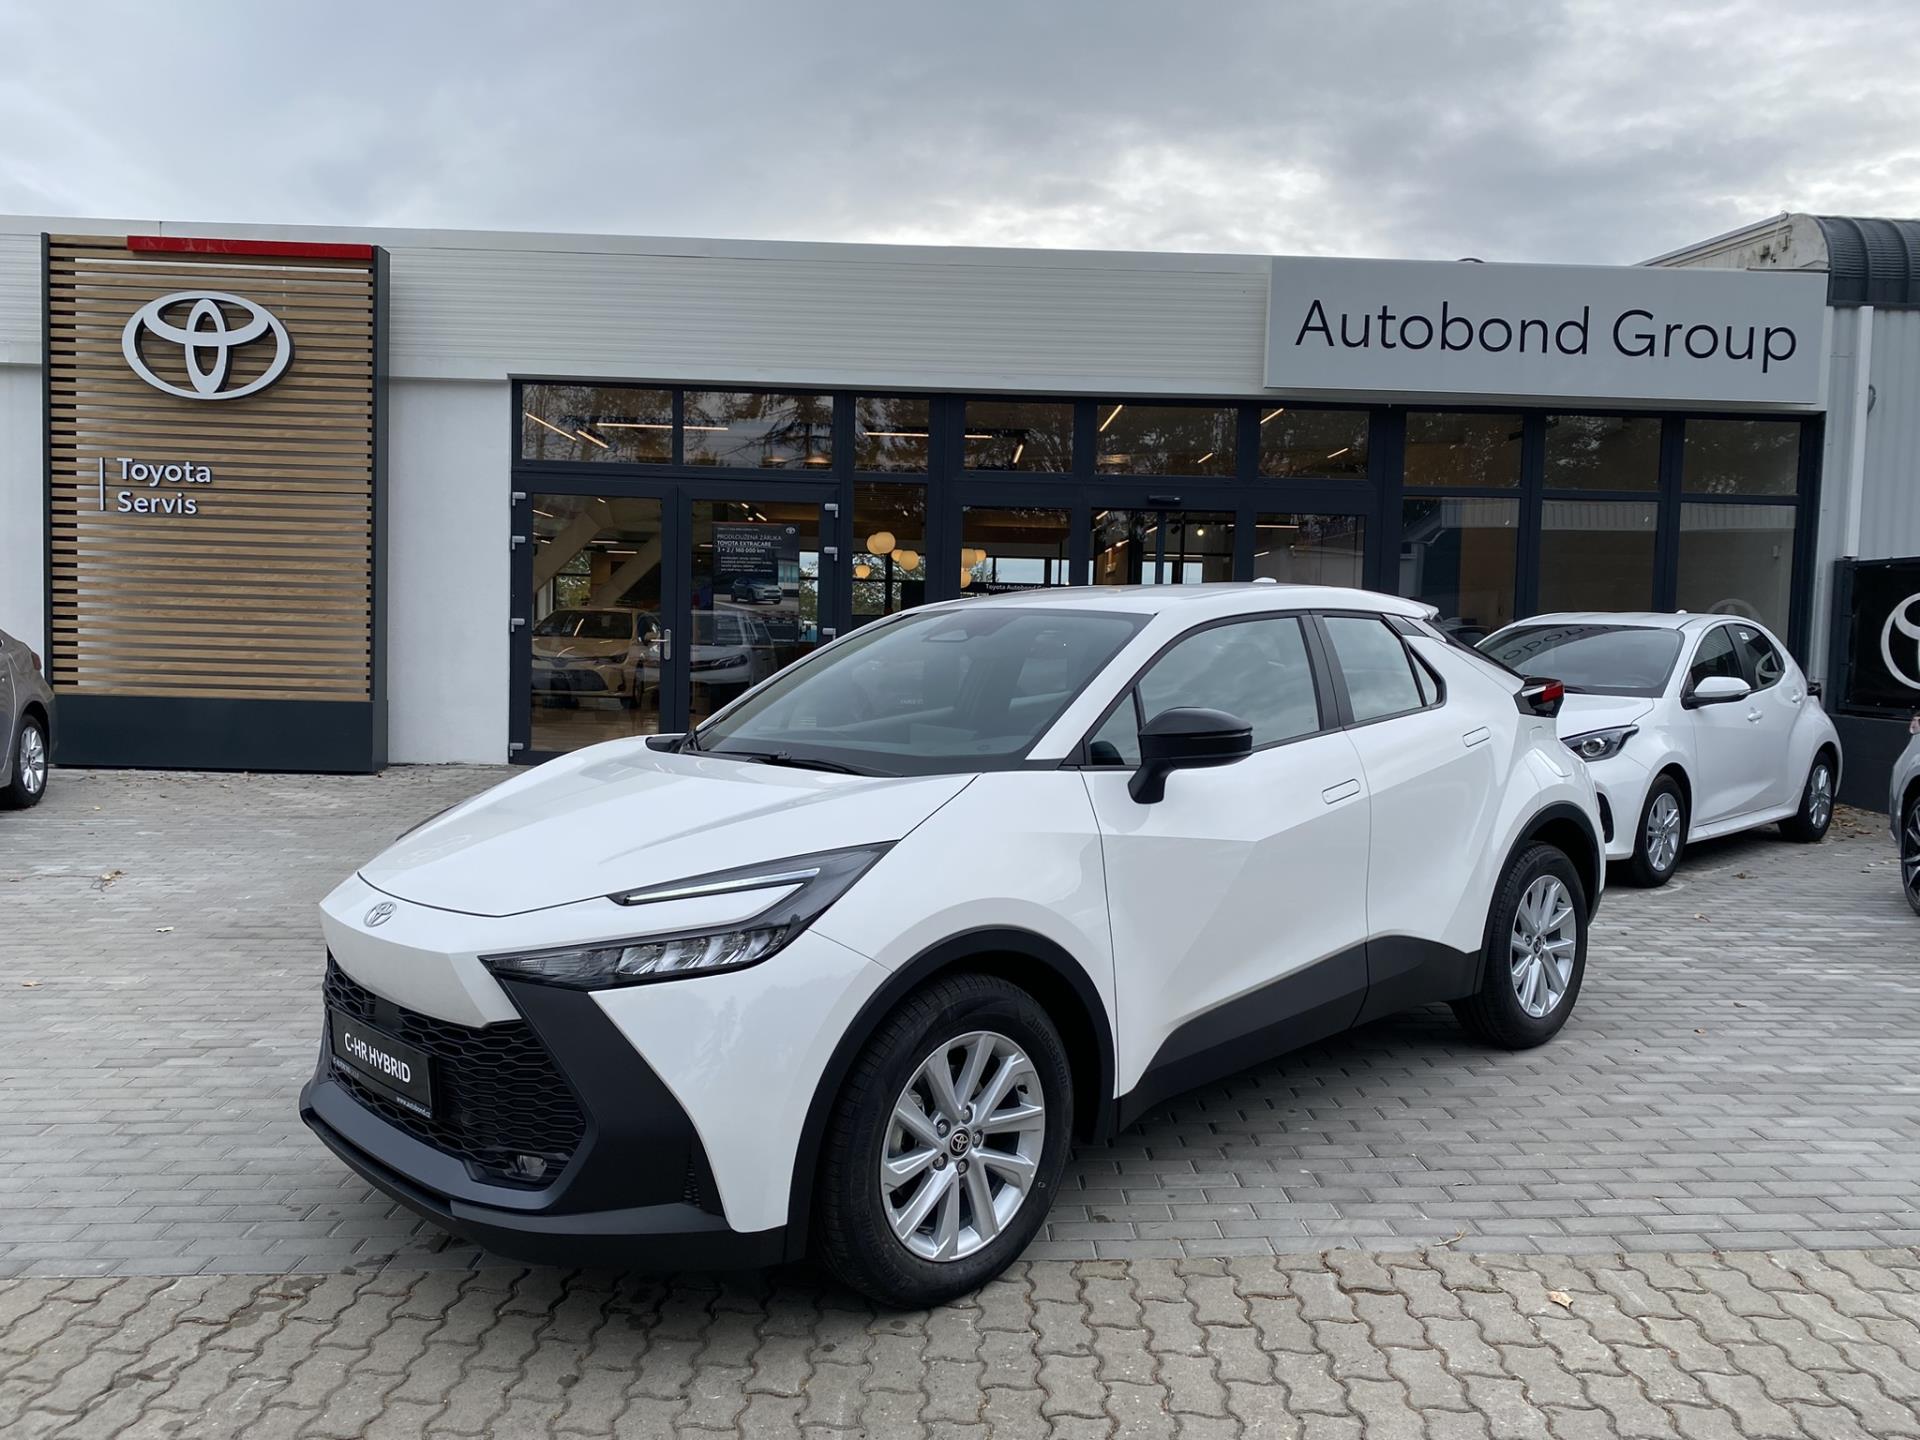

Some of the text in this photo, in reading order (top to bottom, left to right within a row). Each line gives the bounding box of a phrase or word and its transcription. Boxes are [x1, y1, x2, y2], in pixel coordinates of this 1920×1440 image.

[1294, 298, 1798, 373] Autobond Group
[116, 457, 212, 488] Toyota
[117, 490, 198, 515] Servis
[759, 533, 782, 541] ZÁRUKA
[986, 583, 1006, 591] Toyota
[344, 1032, 368, 1062] C-HR
[368, 1045, 411, 1084] HYBRID
